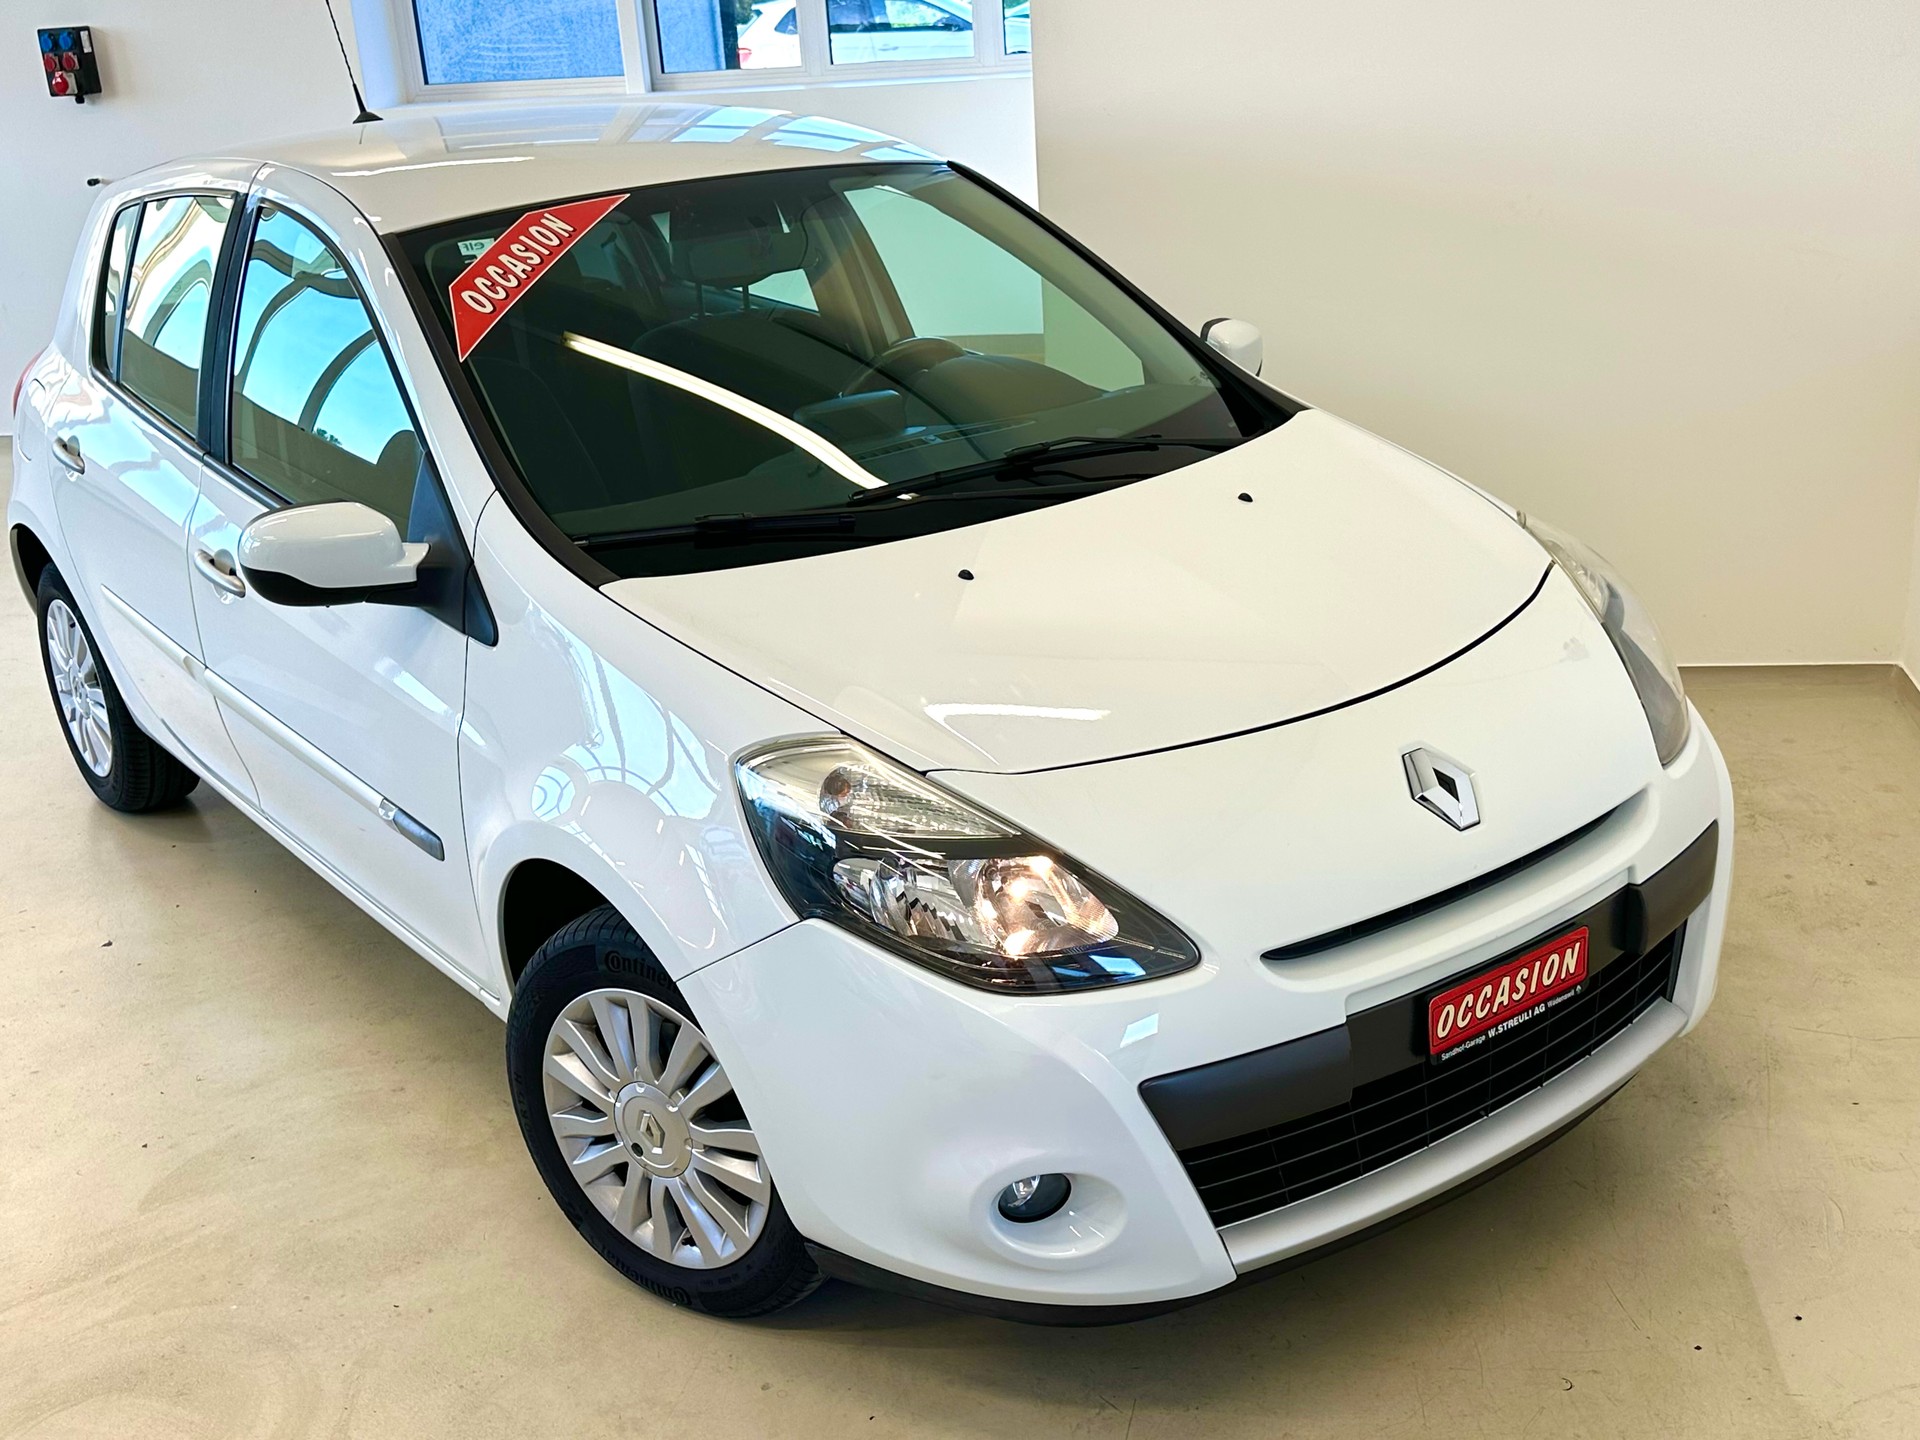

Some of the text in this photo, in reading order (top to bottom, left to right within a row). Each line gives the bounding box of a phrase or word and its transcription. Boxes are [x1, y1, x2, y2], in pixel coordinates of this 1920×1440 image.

[461, 212, 575, 314] OCCASION
[1437, 942, 1581, 1039] OCCASION
[1533, 1003, 1546, 1017] AG
